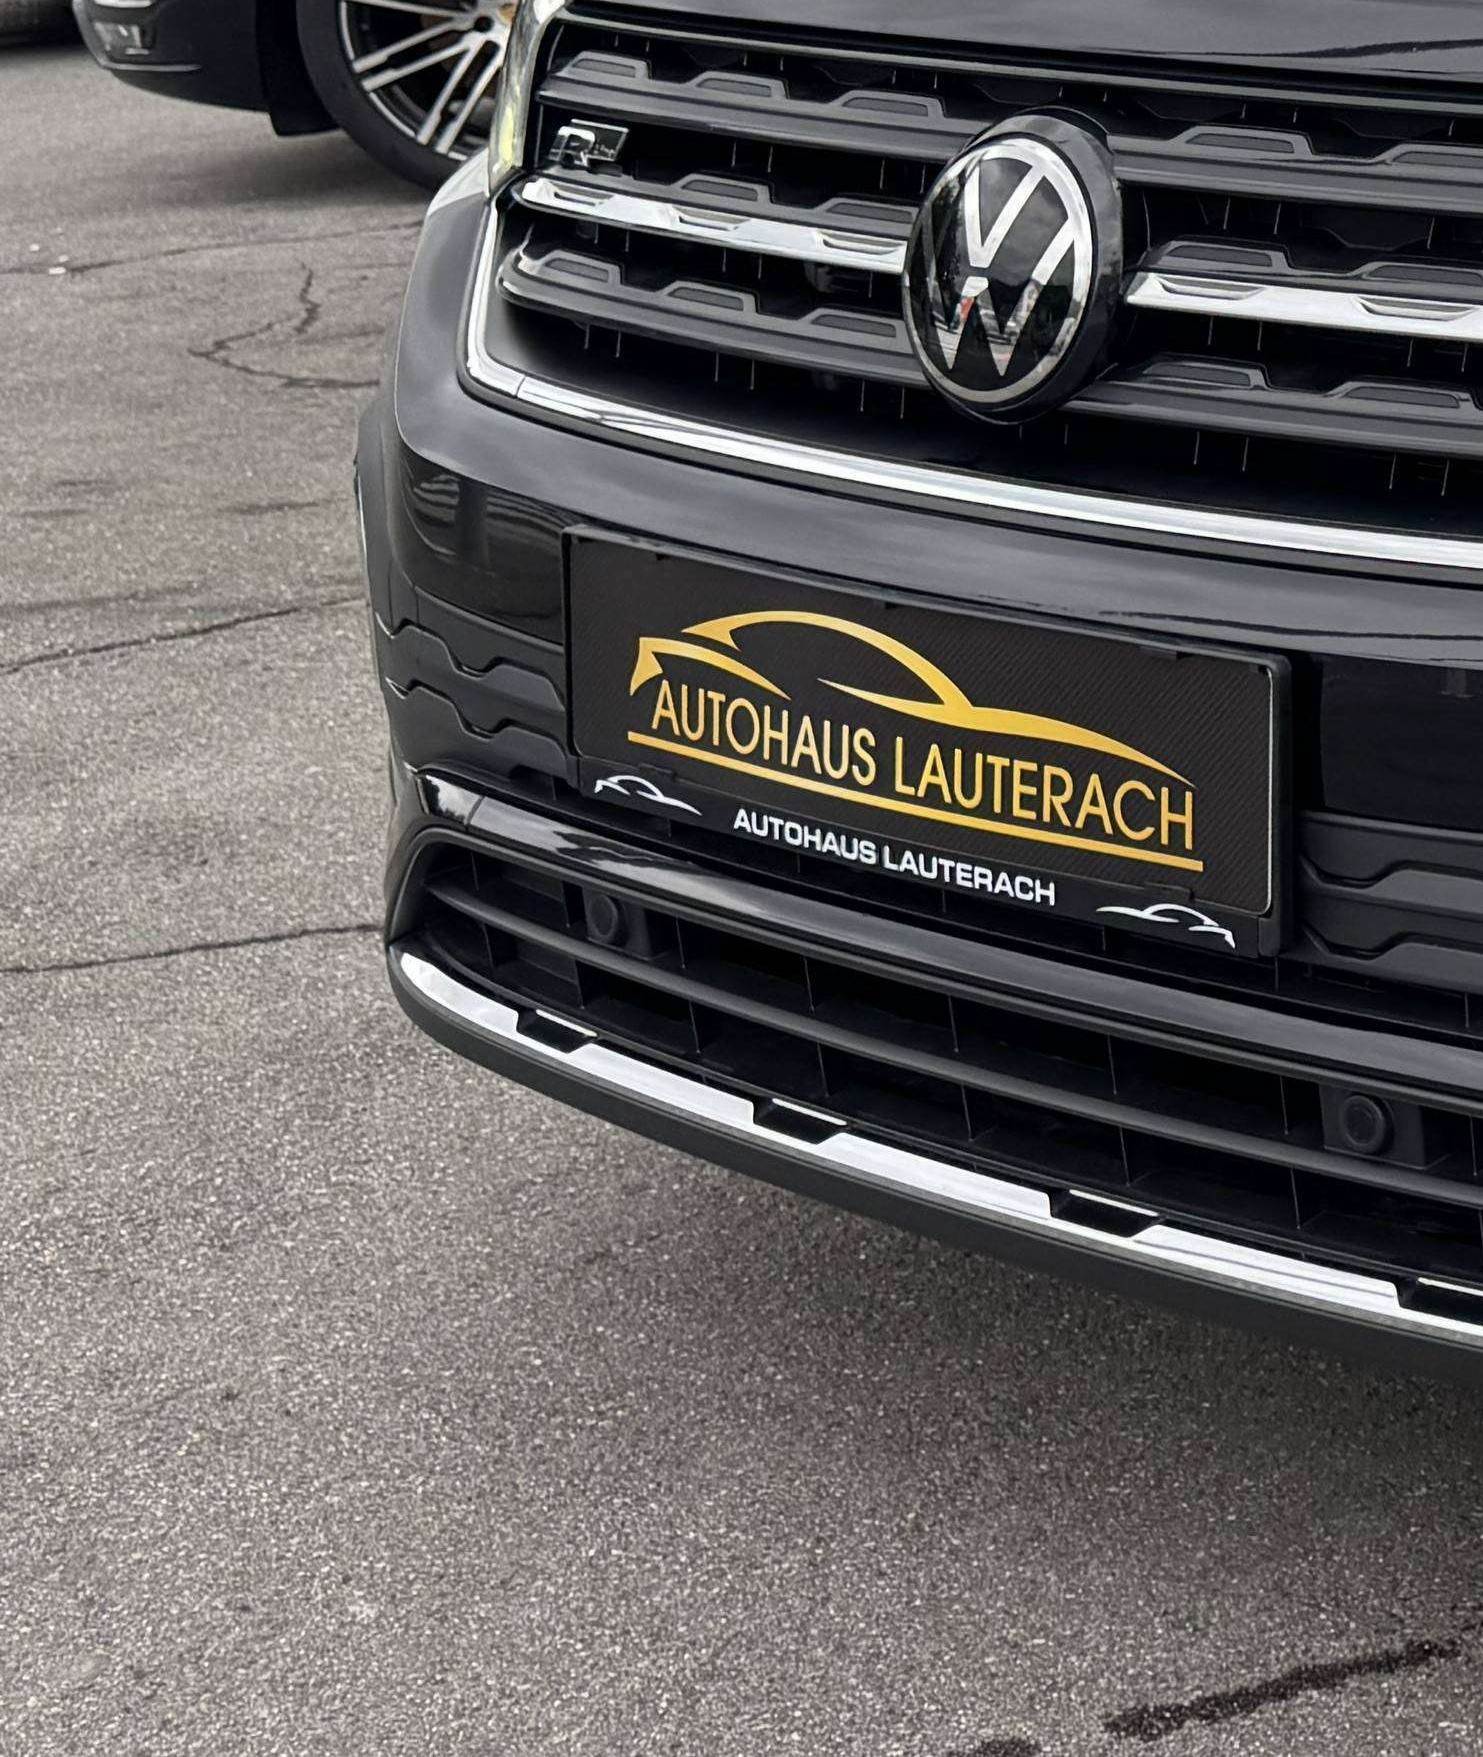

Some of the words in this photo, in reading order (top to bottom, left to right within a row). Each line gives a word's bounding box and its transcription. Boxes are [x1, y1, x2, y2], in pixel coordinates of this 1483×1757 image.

[650, 679, 878, 786] AUTOHAUS
[894, 736, 1195, 850] LAUTERACH
[732, 807, 877, 865] AUTOHAUS
[882, 845, 1056, 907] LAUTERACH
